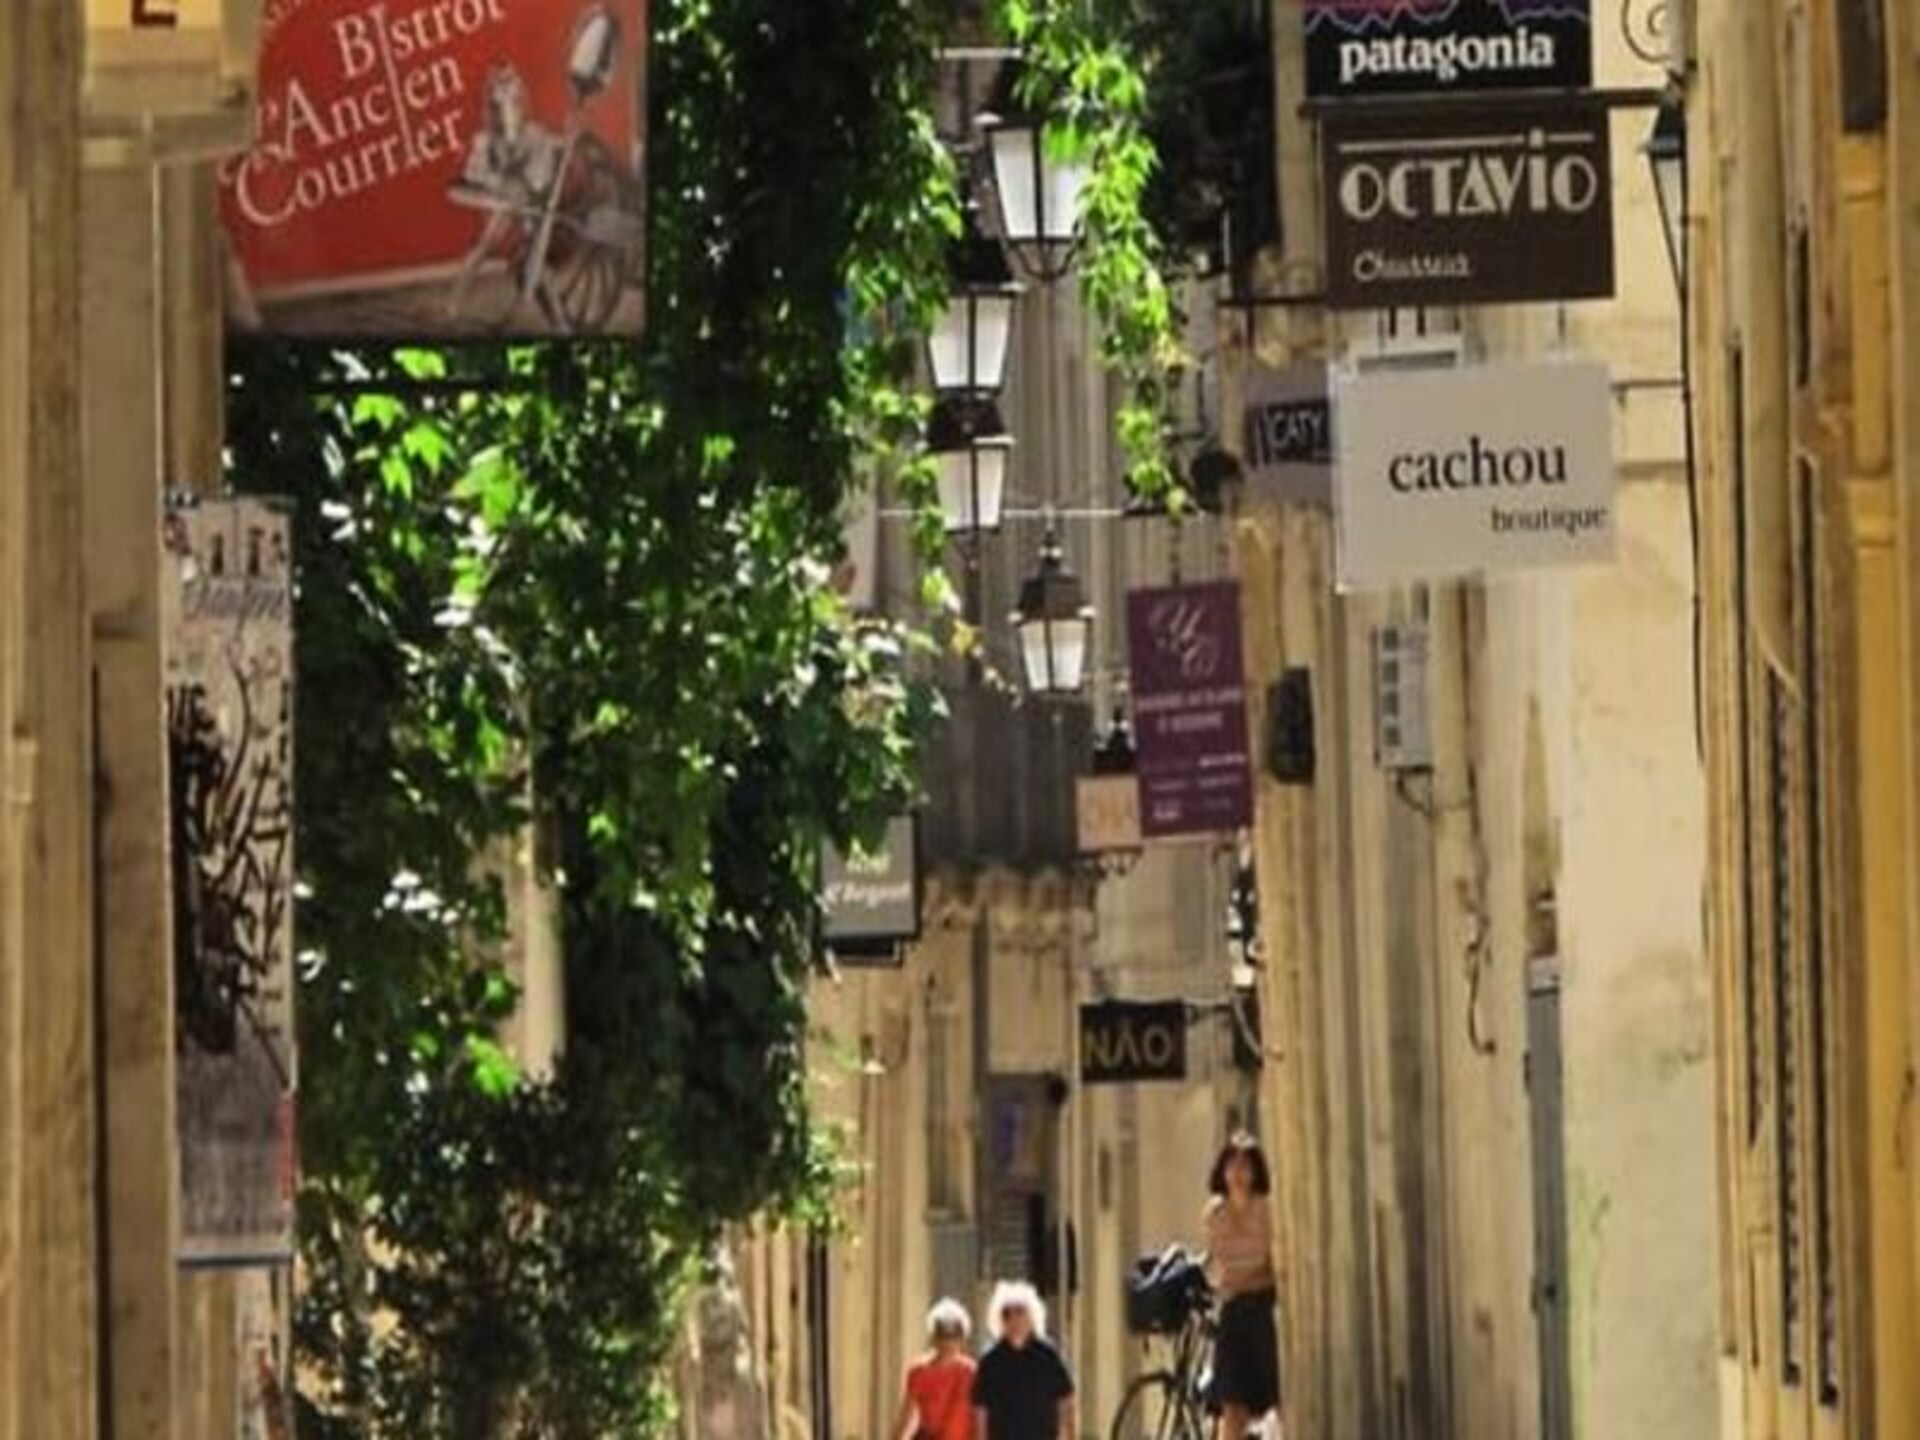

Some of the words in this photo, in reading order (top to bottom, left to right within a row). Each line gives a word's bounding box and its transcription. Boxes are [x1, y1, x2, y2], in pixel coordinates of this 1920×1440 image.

[1339, 26, 1556, 85] patagonia
[1339, 130, 1598, 219] OCTAVIO
[1388, 435, 1567, 493] cachou
[1490, 505, 1610, 538] boutique
